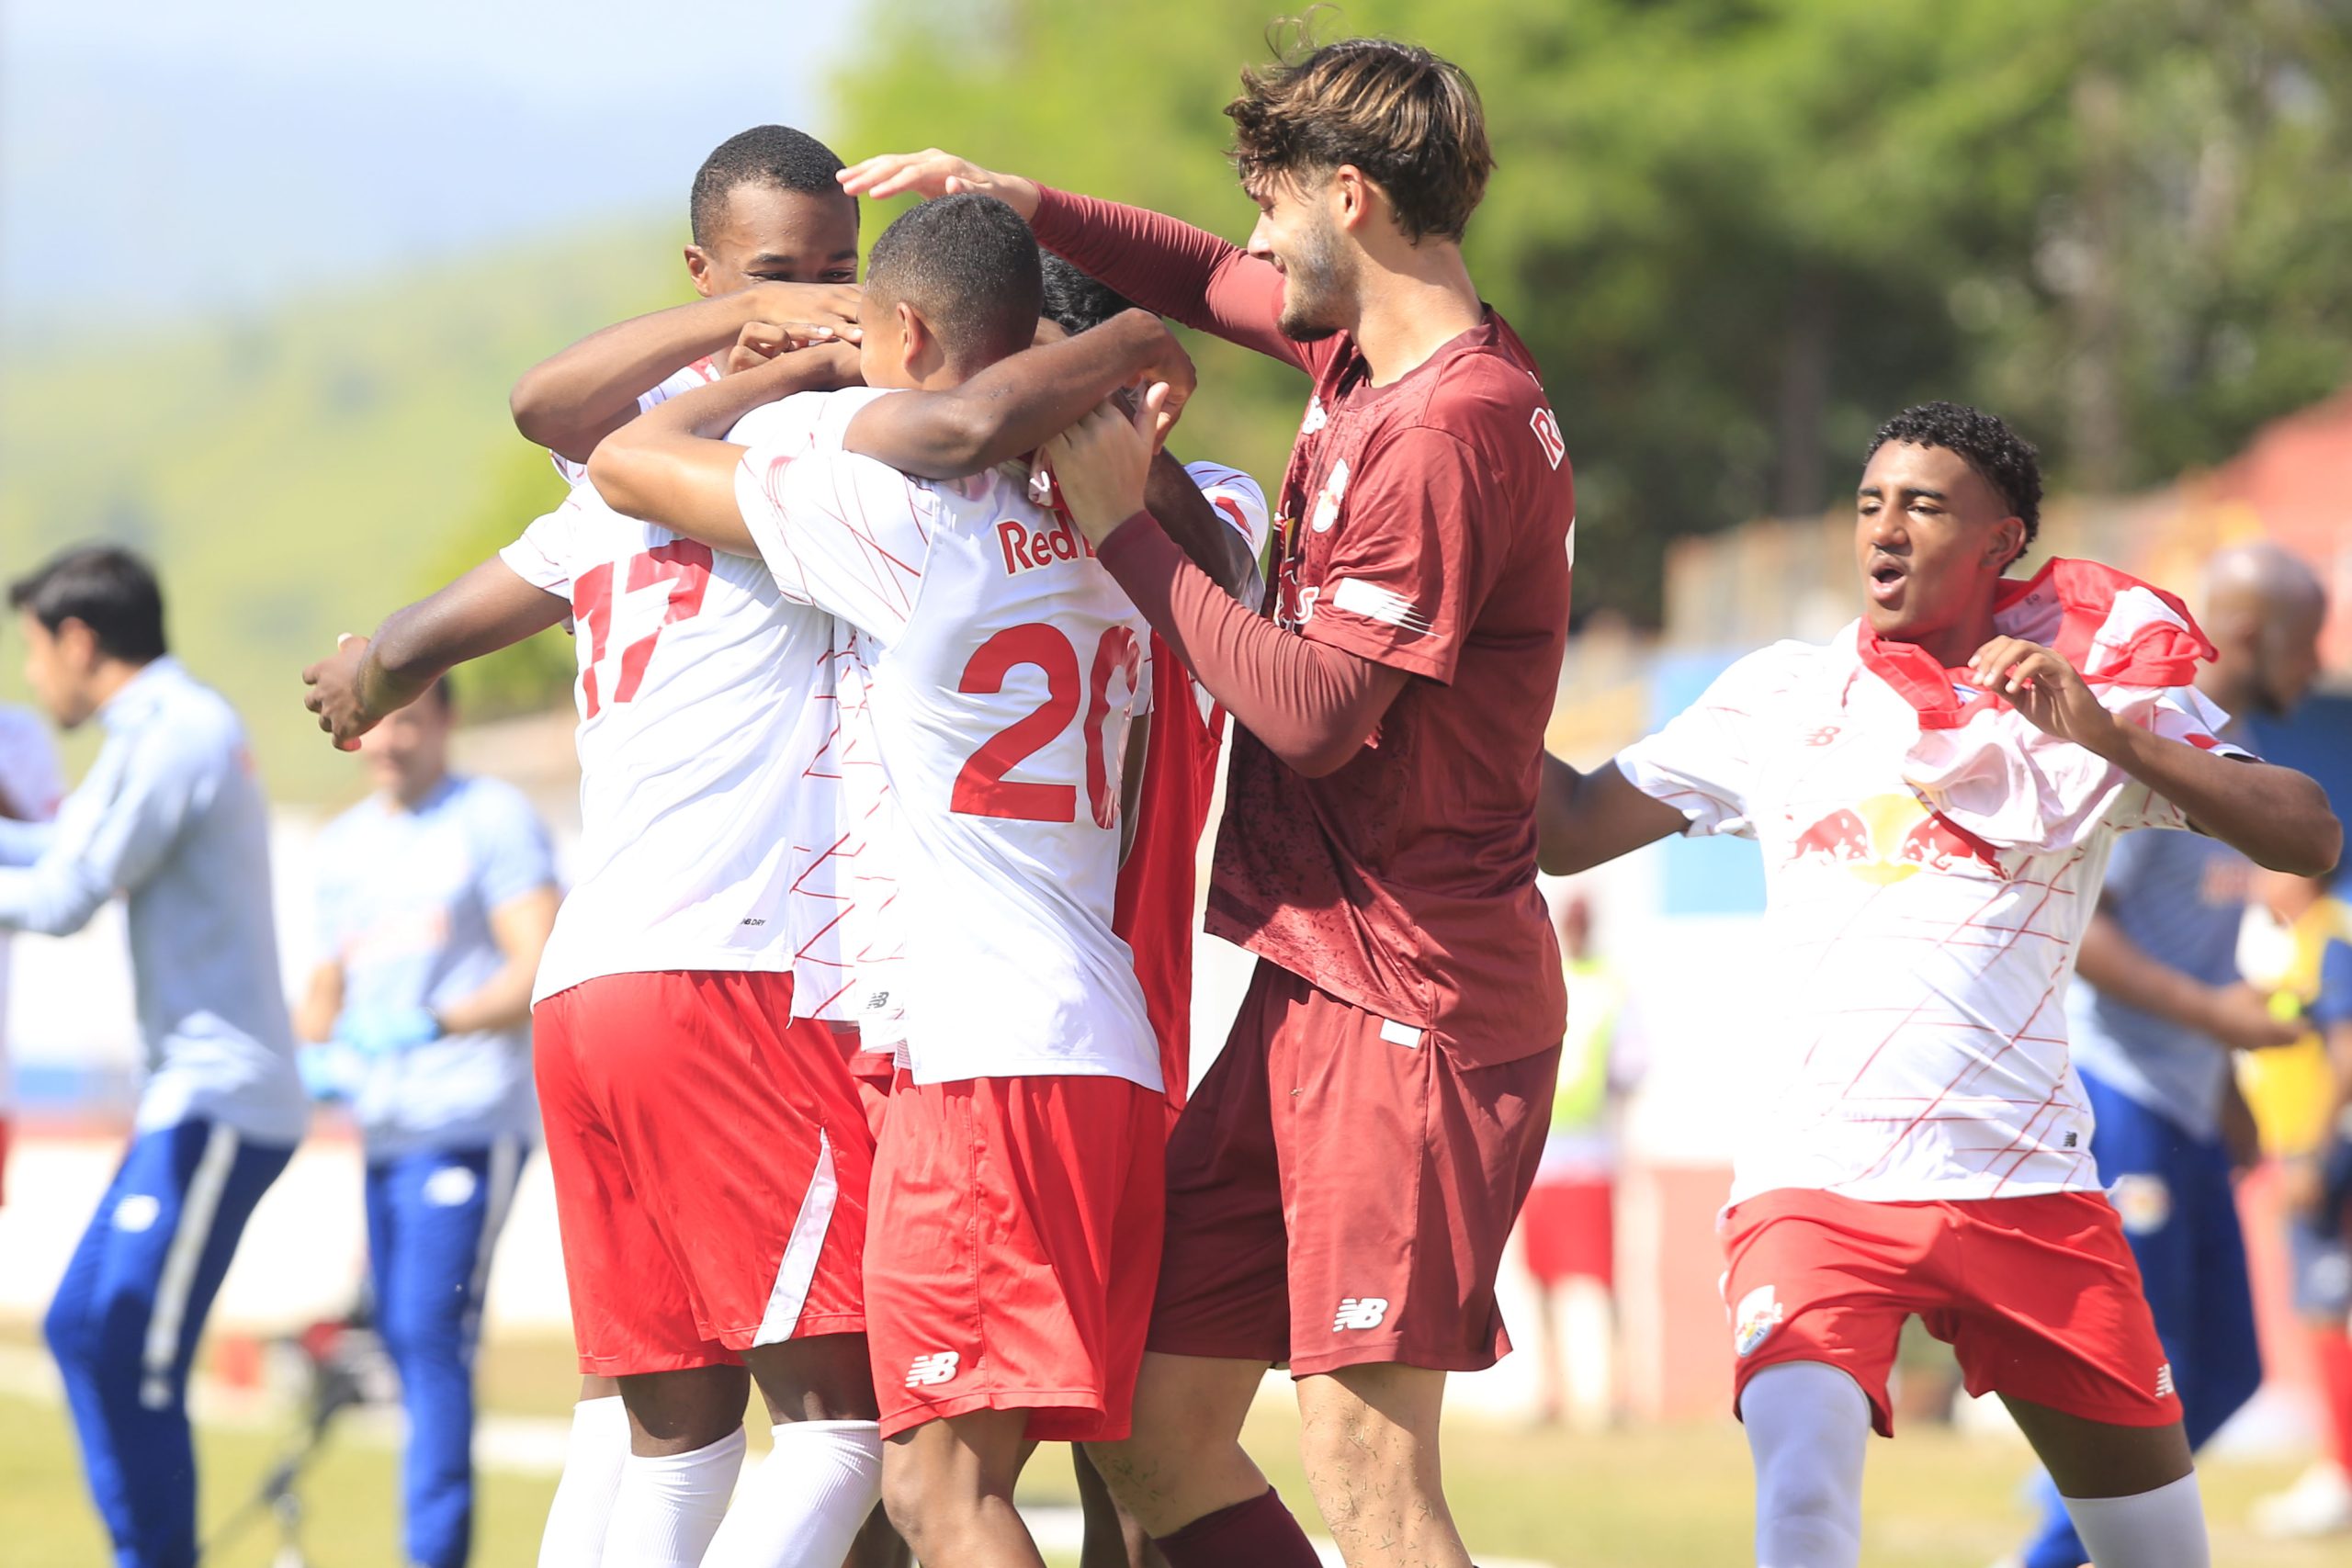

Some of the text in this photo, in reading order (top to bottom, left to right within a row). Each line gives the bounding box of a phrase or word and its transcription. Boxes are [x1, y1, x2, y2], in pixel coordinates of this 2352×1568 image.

[1532, 408, 1565, 468] R
[997, 510, 1079, 575] Red
[572, 537, 714, 720] 17
[950, 623, 1140, 829] 20
[1331, 1298, 1388, 1332] NB
[904, 1350, 959, 1388] NB
